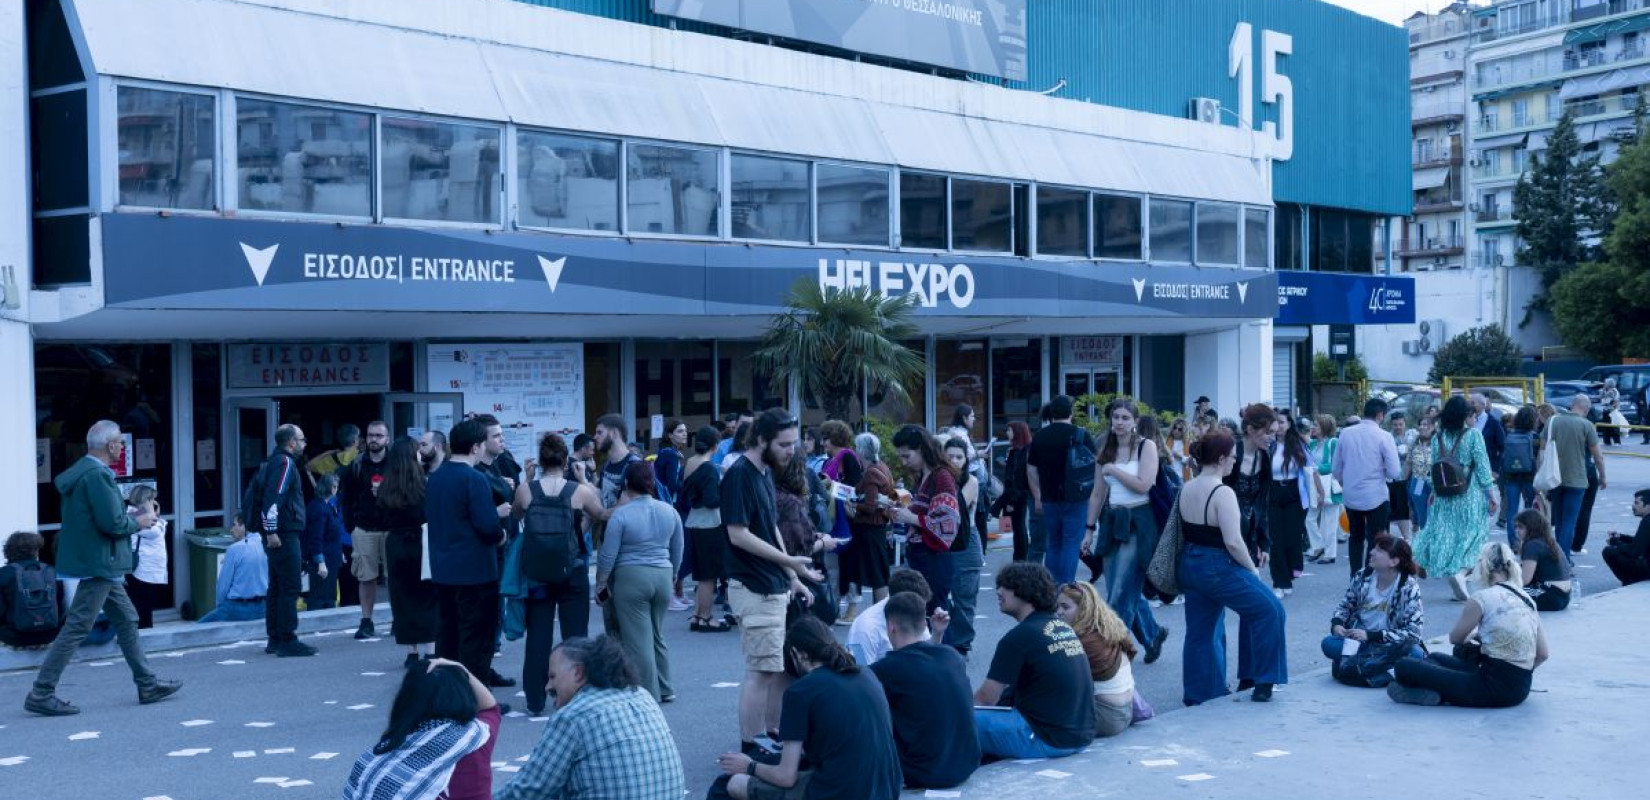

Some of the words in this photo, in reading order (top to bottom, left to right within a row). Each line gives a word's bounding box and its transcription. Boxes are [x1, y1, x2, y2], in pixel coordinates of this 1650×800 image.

[1229, 21, 1293, 161] 15
[411, 257, 515, 282] ENTRANCE
[1191, 284, 1230, 299] ENTRANCE
[252, 345, 370, 364] ΕΙΣΟΔΟΣ
[262, 367, 361, 384] ENTRANCE
